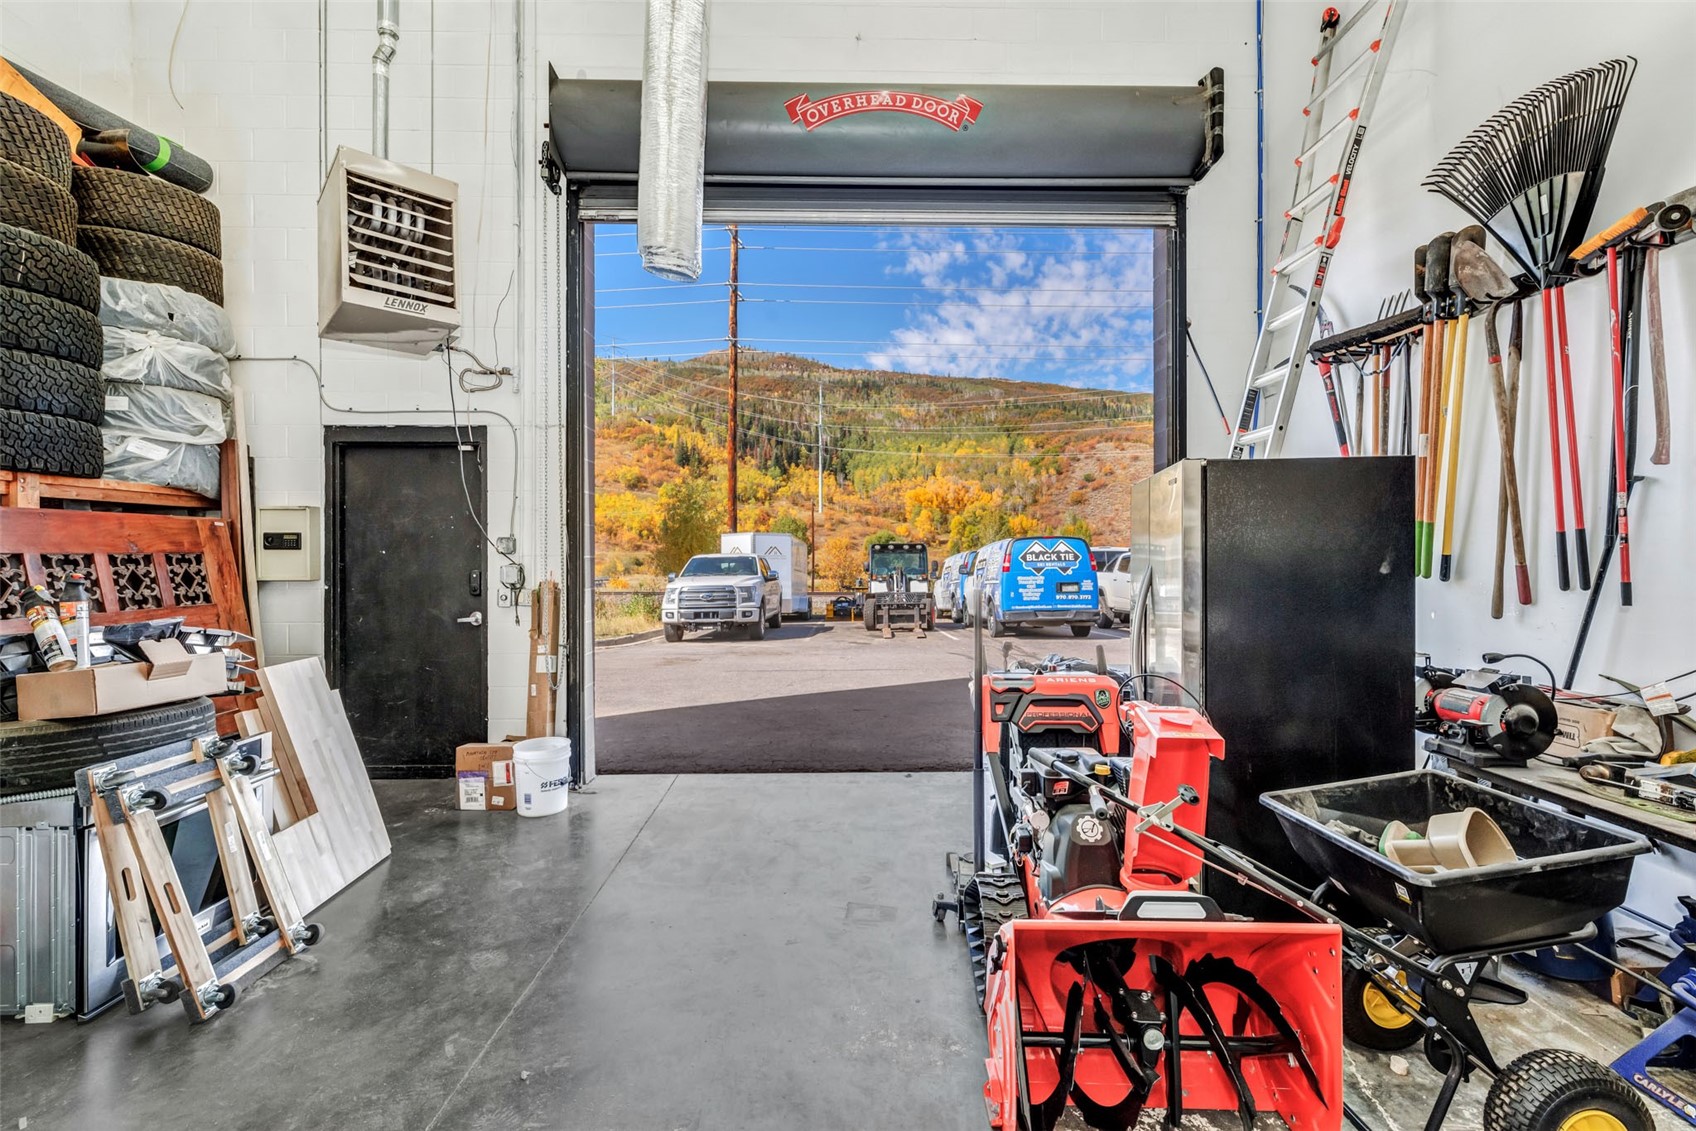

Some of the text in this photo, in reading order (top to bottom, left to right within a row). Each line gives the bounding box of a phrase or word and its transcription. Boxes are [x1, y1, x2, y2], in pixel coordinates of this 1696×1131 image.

[806, 94, 960, 125] OVERHEAD DOOR
[1345, 144, 1359, 175] VELOCITY
[384, 296, 429, 313] LENNOX
[1026, 553, 1075, 562] BLACK TIE
[1633, 1074, 1686, 1110] CARLYLE
